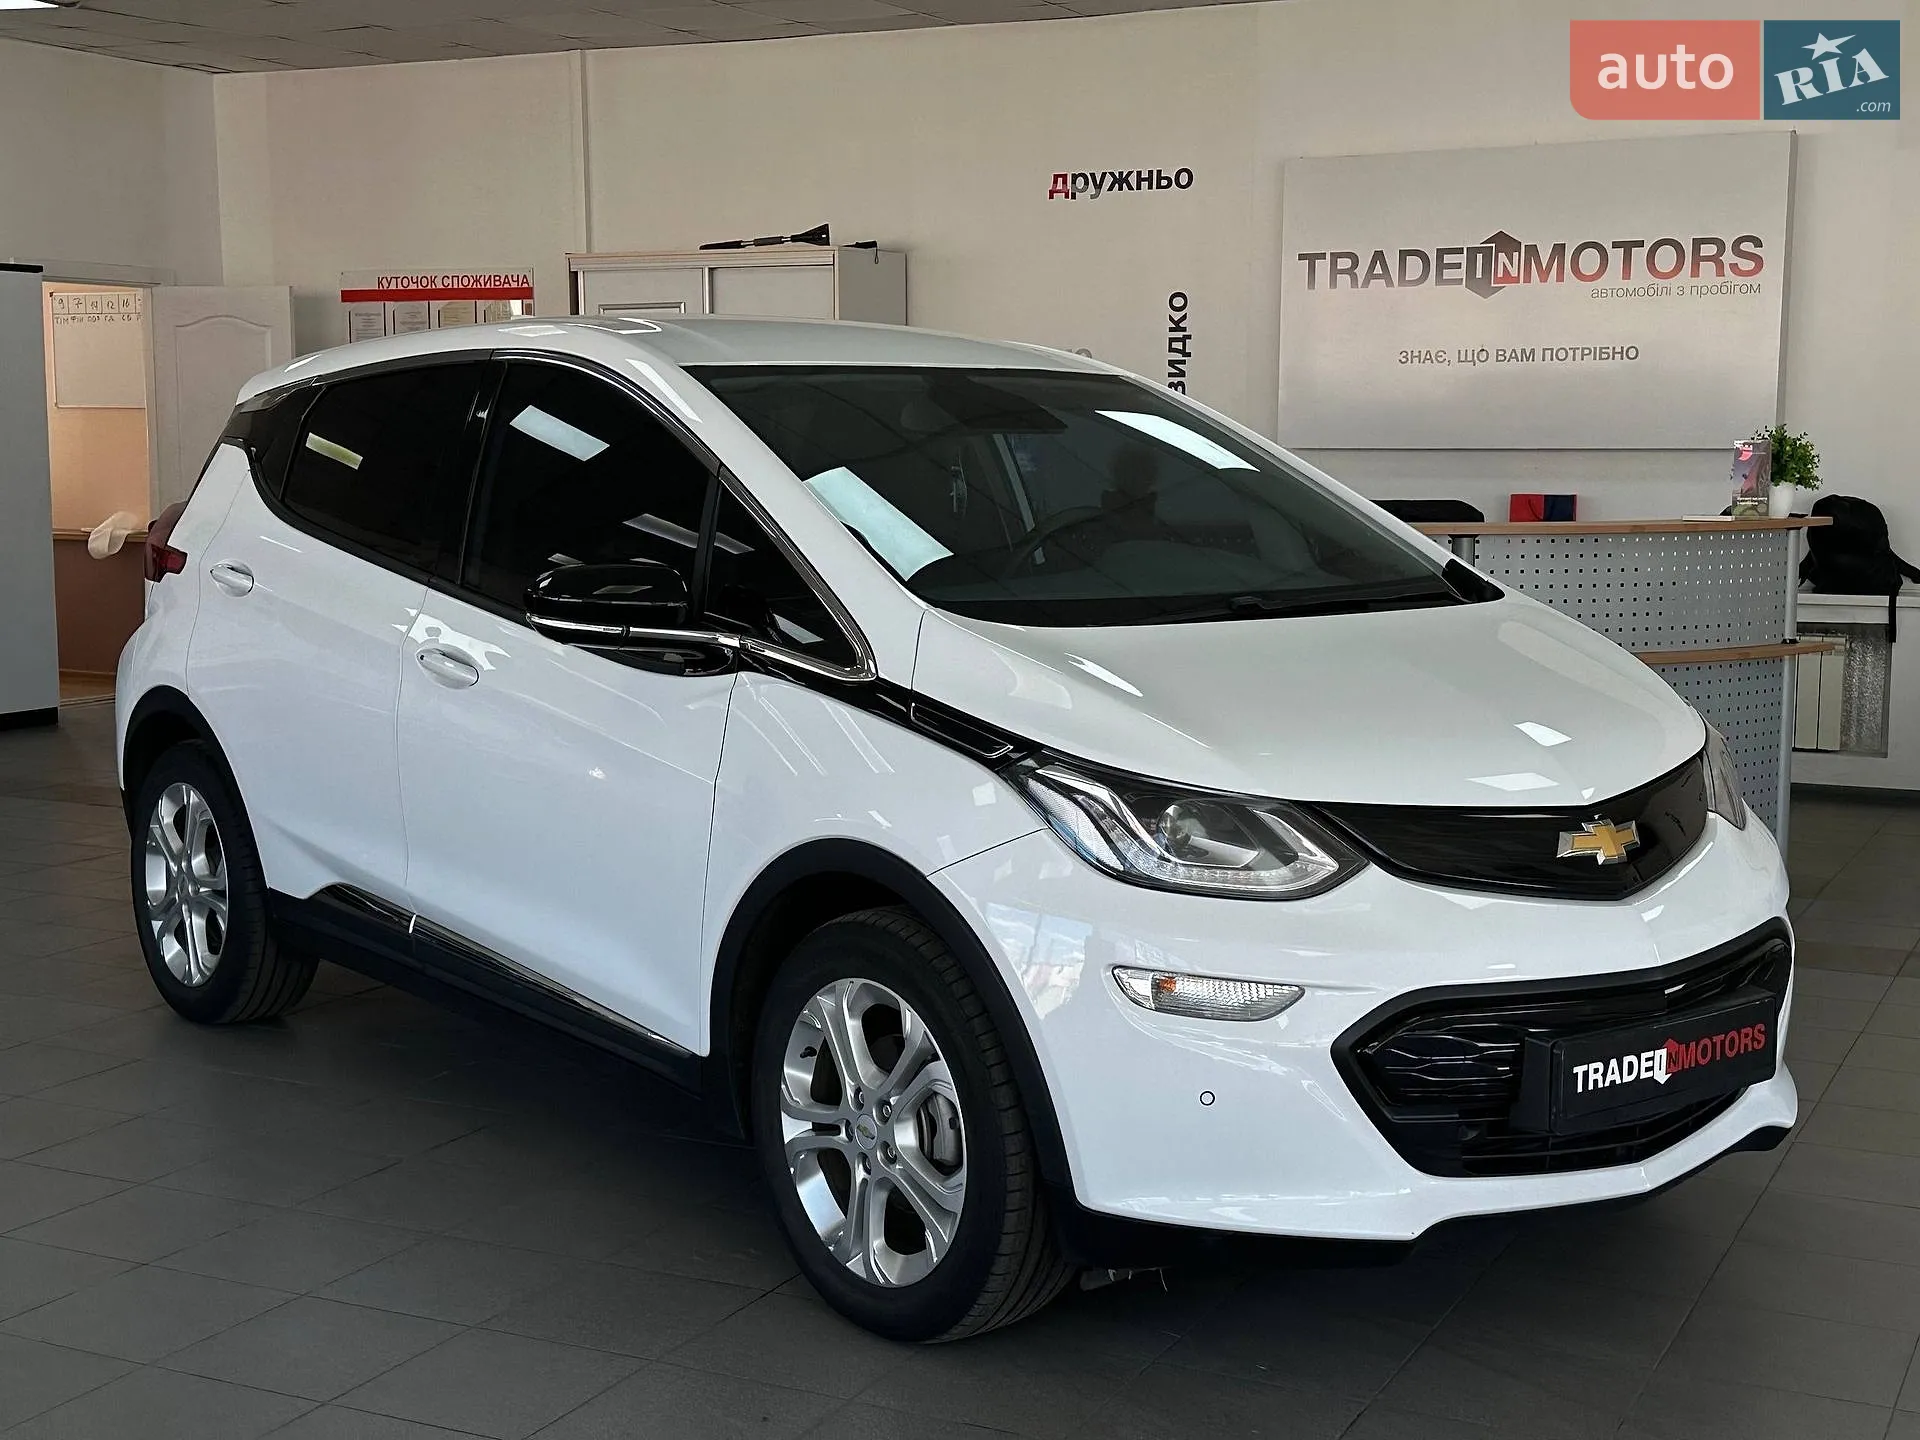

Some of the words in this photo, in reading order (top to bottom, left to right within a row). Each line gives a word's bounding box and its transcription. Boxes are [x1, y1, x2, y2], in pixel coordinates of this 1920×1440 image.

[1048, 167, 1194, 200] дружньо
[377, 275, 438, 289] КУТОЧОК
[441, 274, 530, 289] СПОЖИВАЧА
[1590, 282, 1672, 299] автомобілі
[1676, 284, 1685, 297] з
[1689, 280, 1762, 299] пробігом
[1167, 291, 1193, 396] видко
[1398, 349, 1452, 366] ЗНАЄ,
[1457, 348, 1490, 366] ЩО
[1495, 347, 1536, 363] ВАМ
[1541, 345, 1640, 363] ПОТРІБНО
